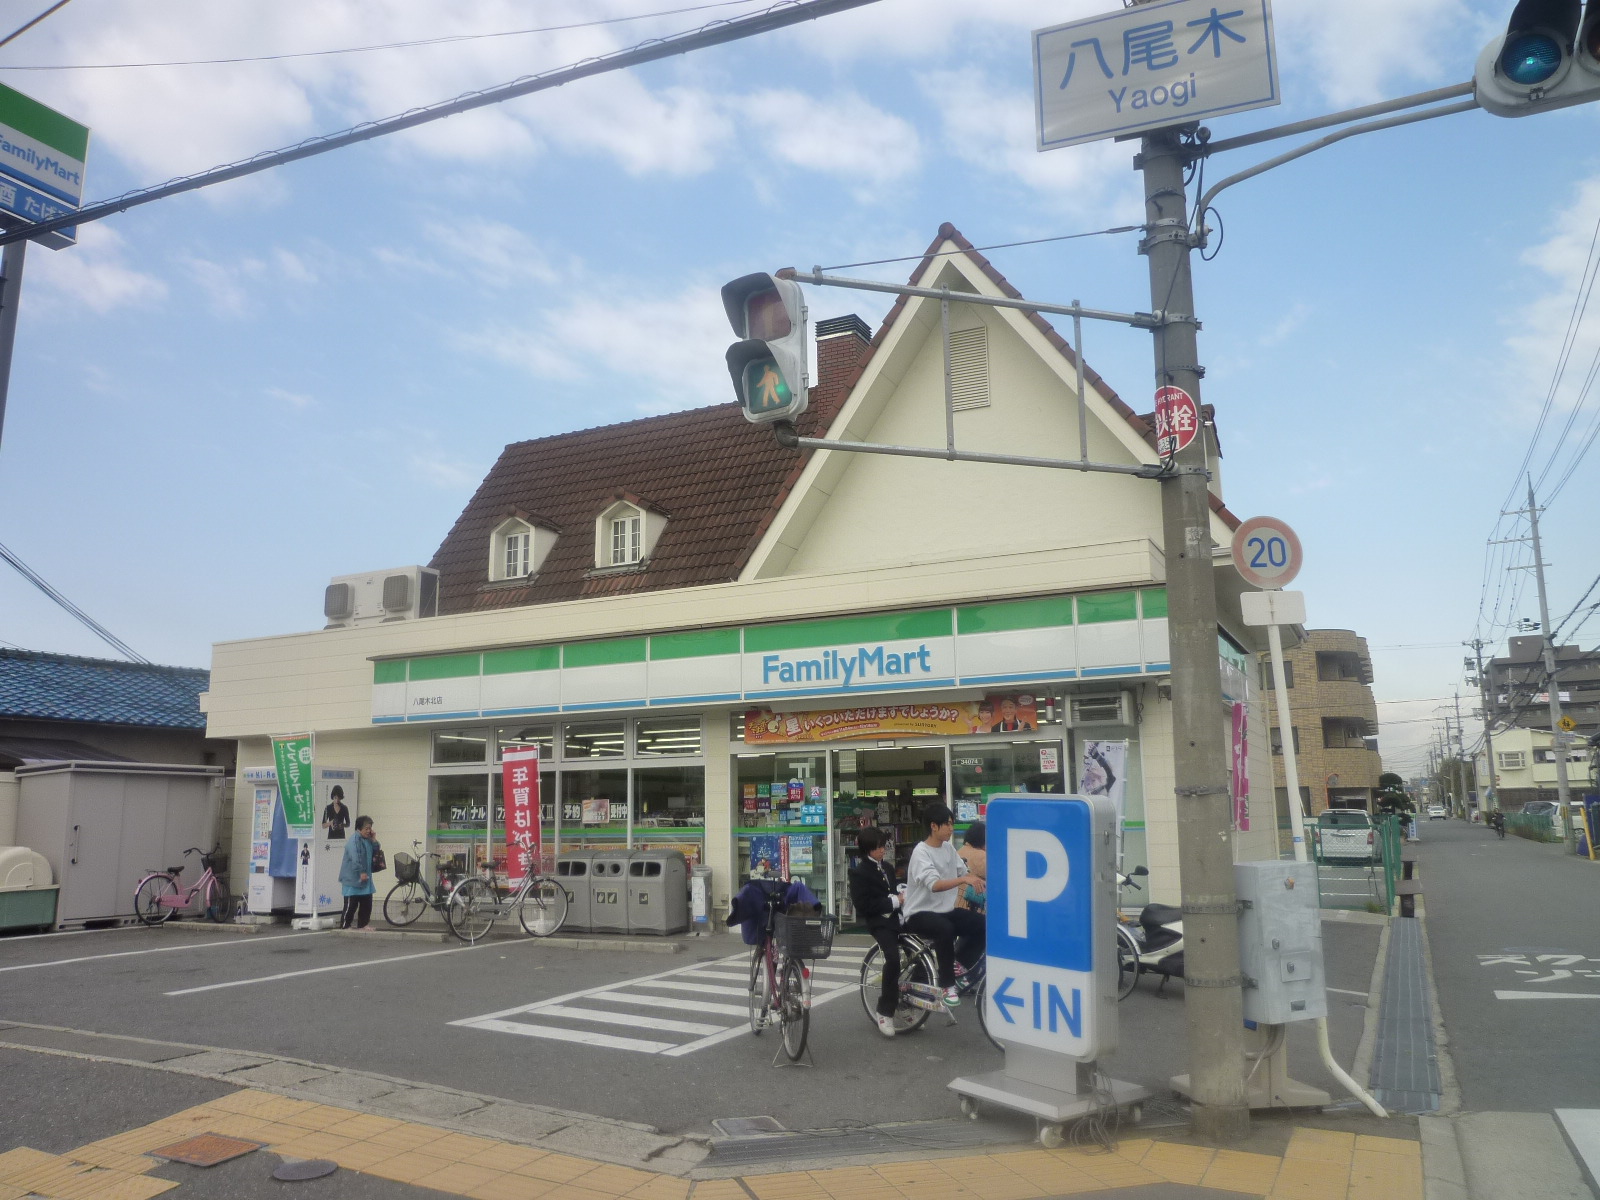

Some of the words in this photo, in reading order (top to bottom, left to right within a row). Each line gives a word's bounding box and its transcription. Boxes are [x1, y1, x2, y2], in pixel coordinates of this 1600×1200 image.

[1059, 7, 1247, 91] 八尾木
[1107, 72, 1197, 114] Yaogi
[1155, 405, 1194, 438] 火栓
[1247, 536, 1287, 568] 20
[762, 643, 931, 687] FamilyMart
[412, 696, 443, 706] 八尾木北店
[563, 804, 581, 819] 予約
[801, 805, 823, 813] たばこ
[805, 815, 820, 824] お酒
[1007, 828, 1070, 939] P
[1031, 981, 1083, 1038] IN
